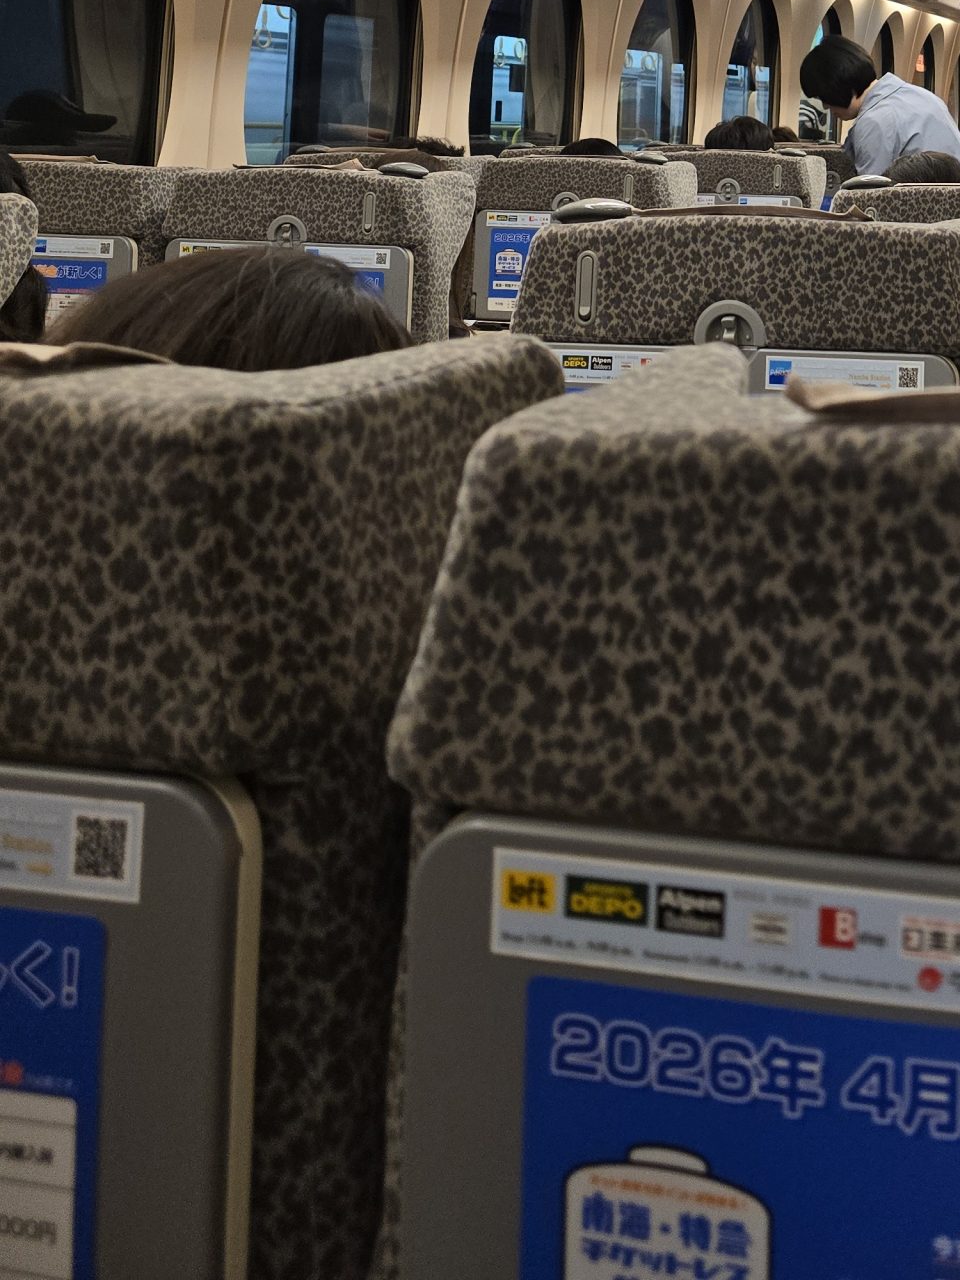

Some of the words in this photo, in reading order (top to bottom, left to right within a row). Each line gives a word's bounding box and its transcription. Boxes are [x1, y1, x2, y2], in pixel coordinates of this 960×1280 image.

[592, 356, 612, 364] Alpen
[570, 893, 643, 919] DEPO
[659, 889, 722, 913] Alpen
